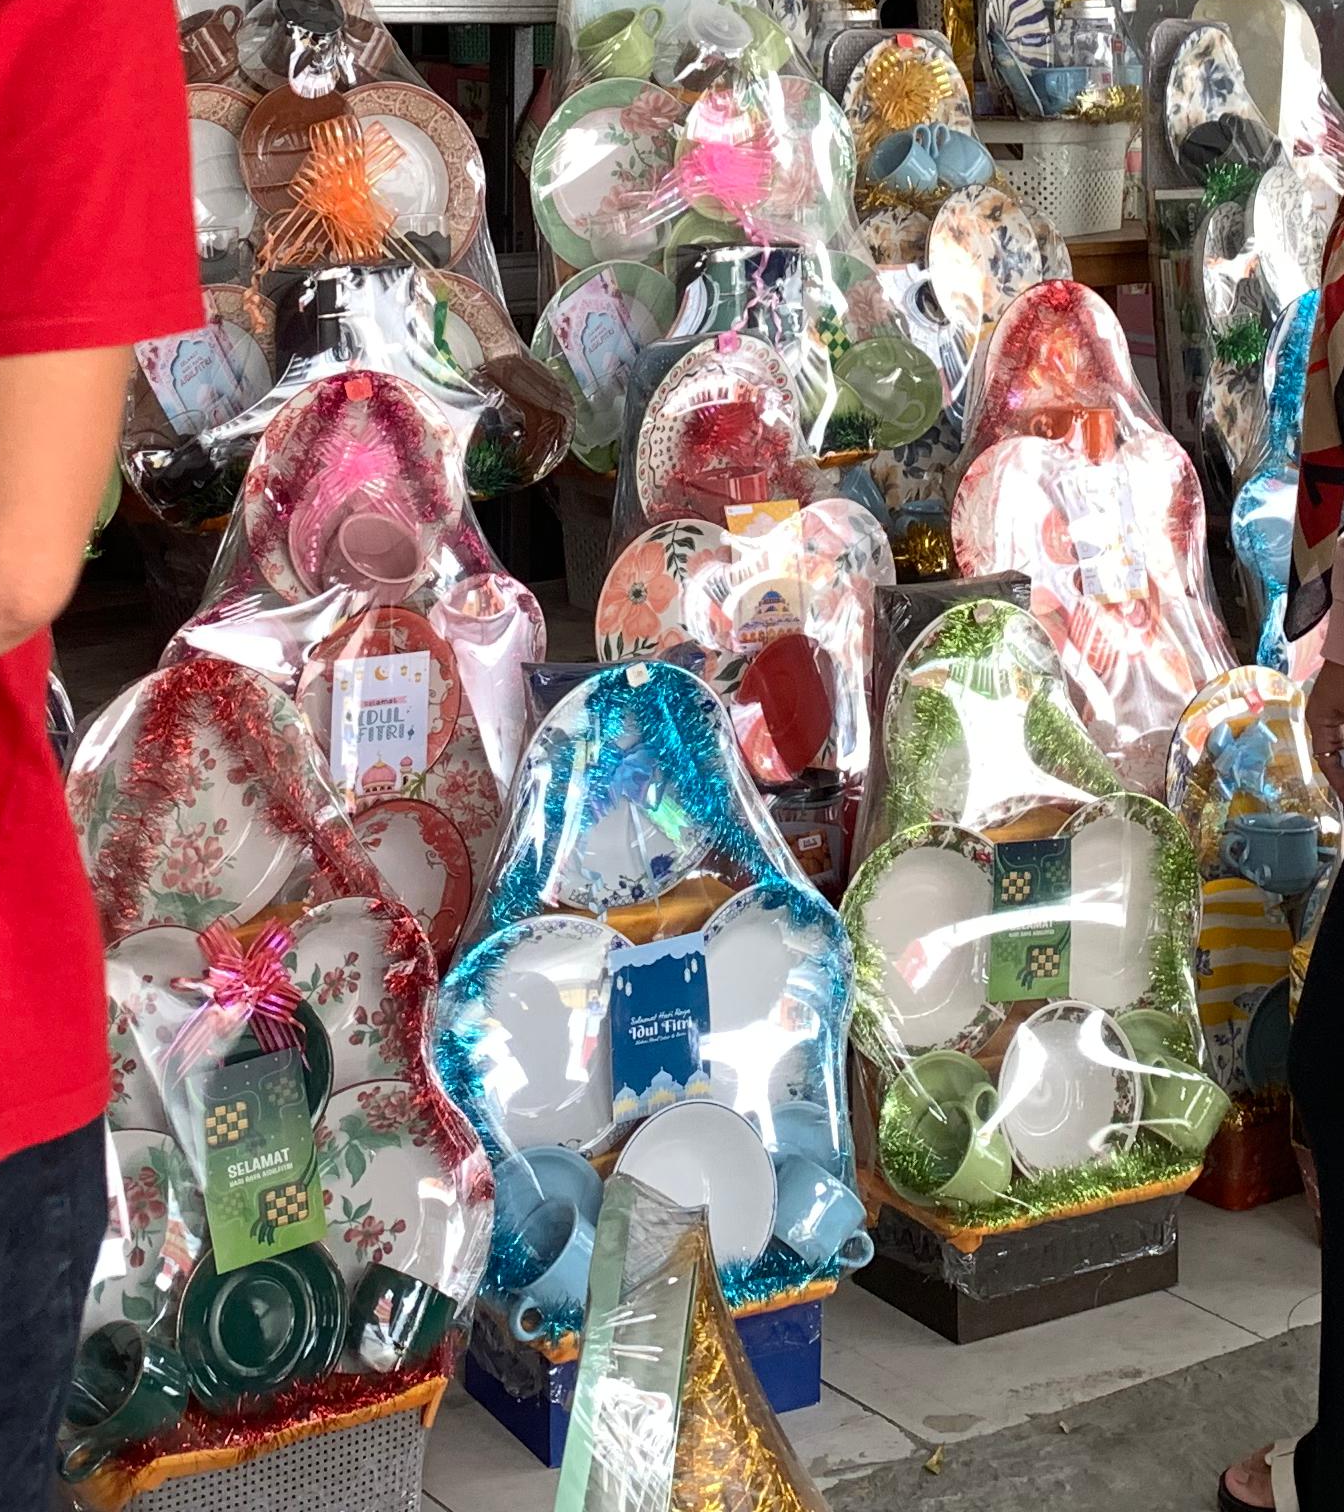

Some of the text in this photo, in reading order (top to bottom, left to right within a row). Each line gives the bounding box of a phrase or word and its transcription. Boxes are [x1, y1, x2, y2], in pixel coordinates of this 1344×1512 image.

[358, 706, 405, 727] IDUL
[358, 724, 405, 743] FITRI
[629, 1021, 658, 1040] Idul
[227, 1147, 290, 1179] SELAMAT
[229, 1178, 244, 1188] HARI
[245, 1173, 261, 1184] RAYA
